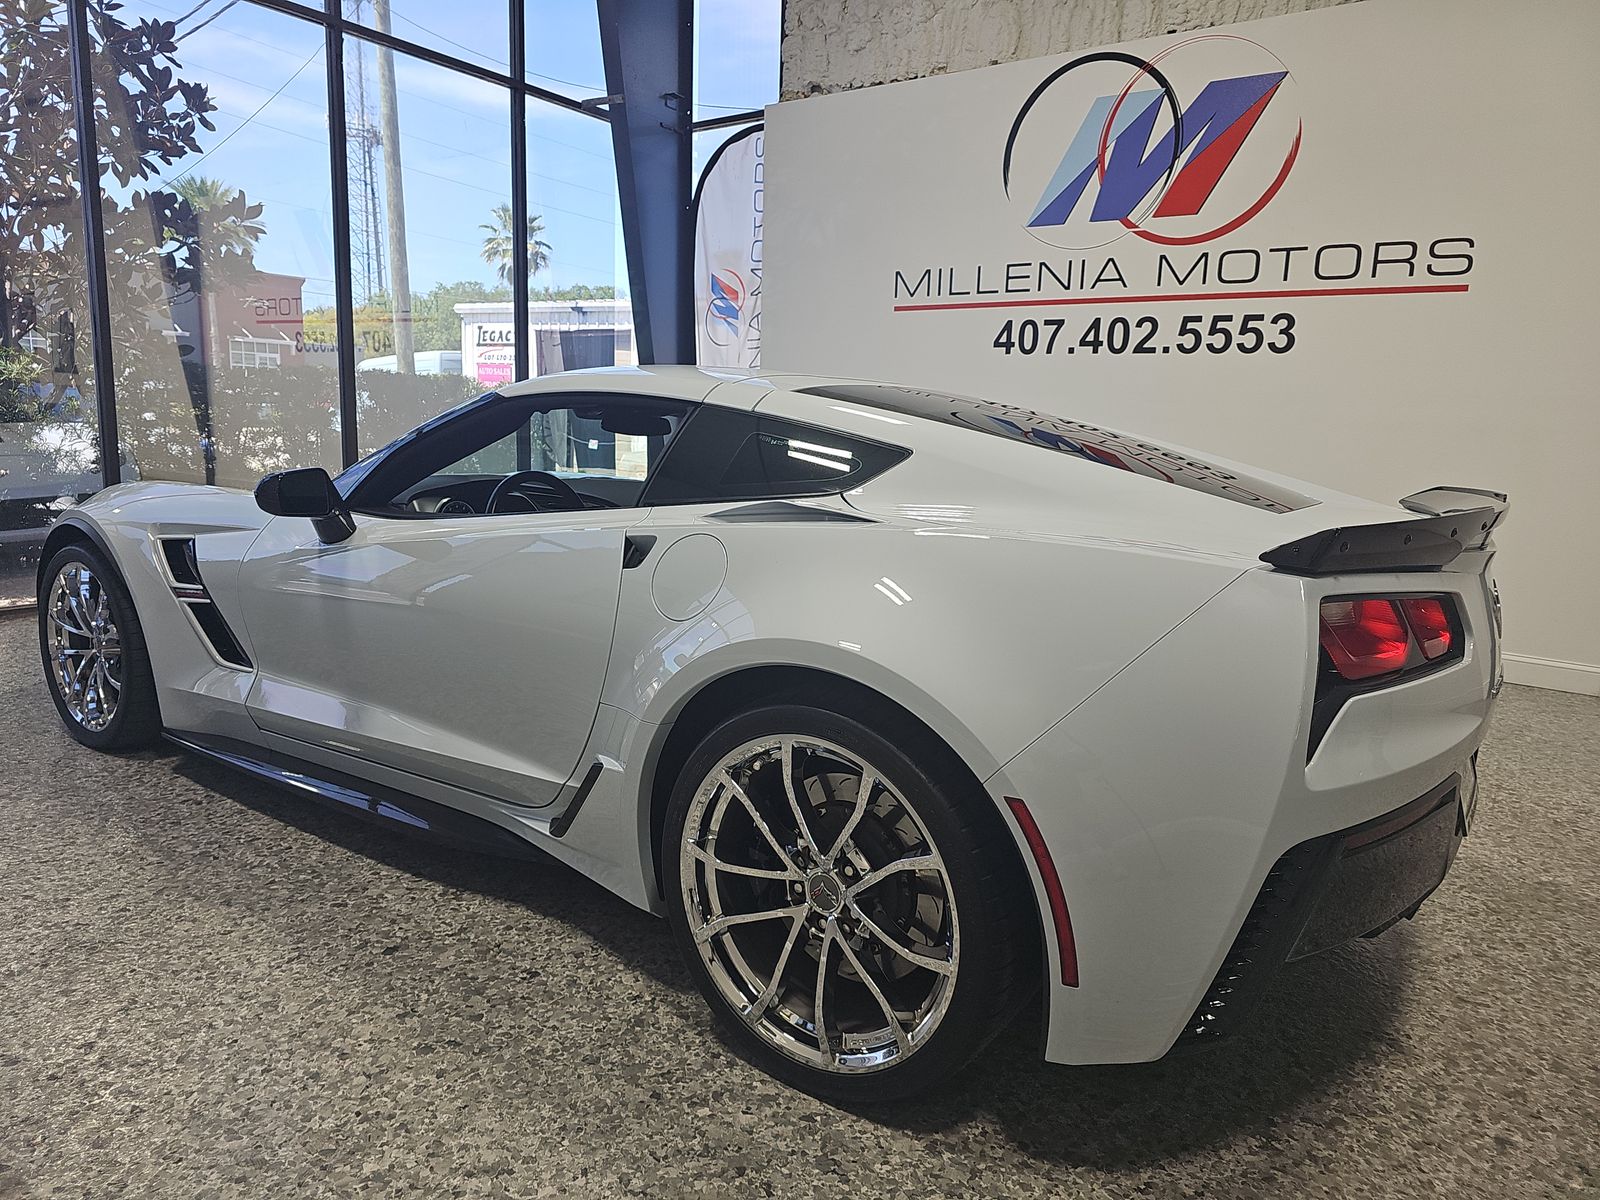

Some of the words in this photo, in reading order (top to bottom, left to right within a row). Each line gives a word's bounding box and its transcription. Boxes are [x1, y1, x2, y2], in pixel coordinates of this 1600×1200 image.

[894, 257, 1128, 299] MILLENIA
[1156, 237, 1476, 287] MOTORS
[476, 325, 514, 347] LEGAC
[993, 312, 1297, 356] 407.402.5553
